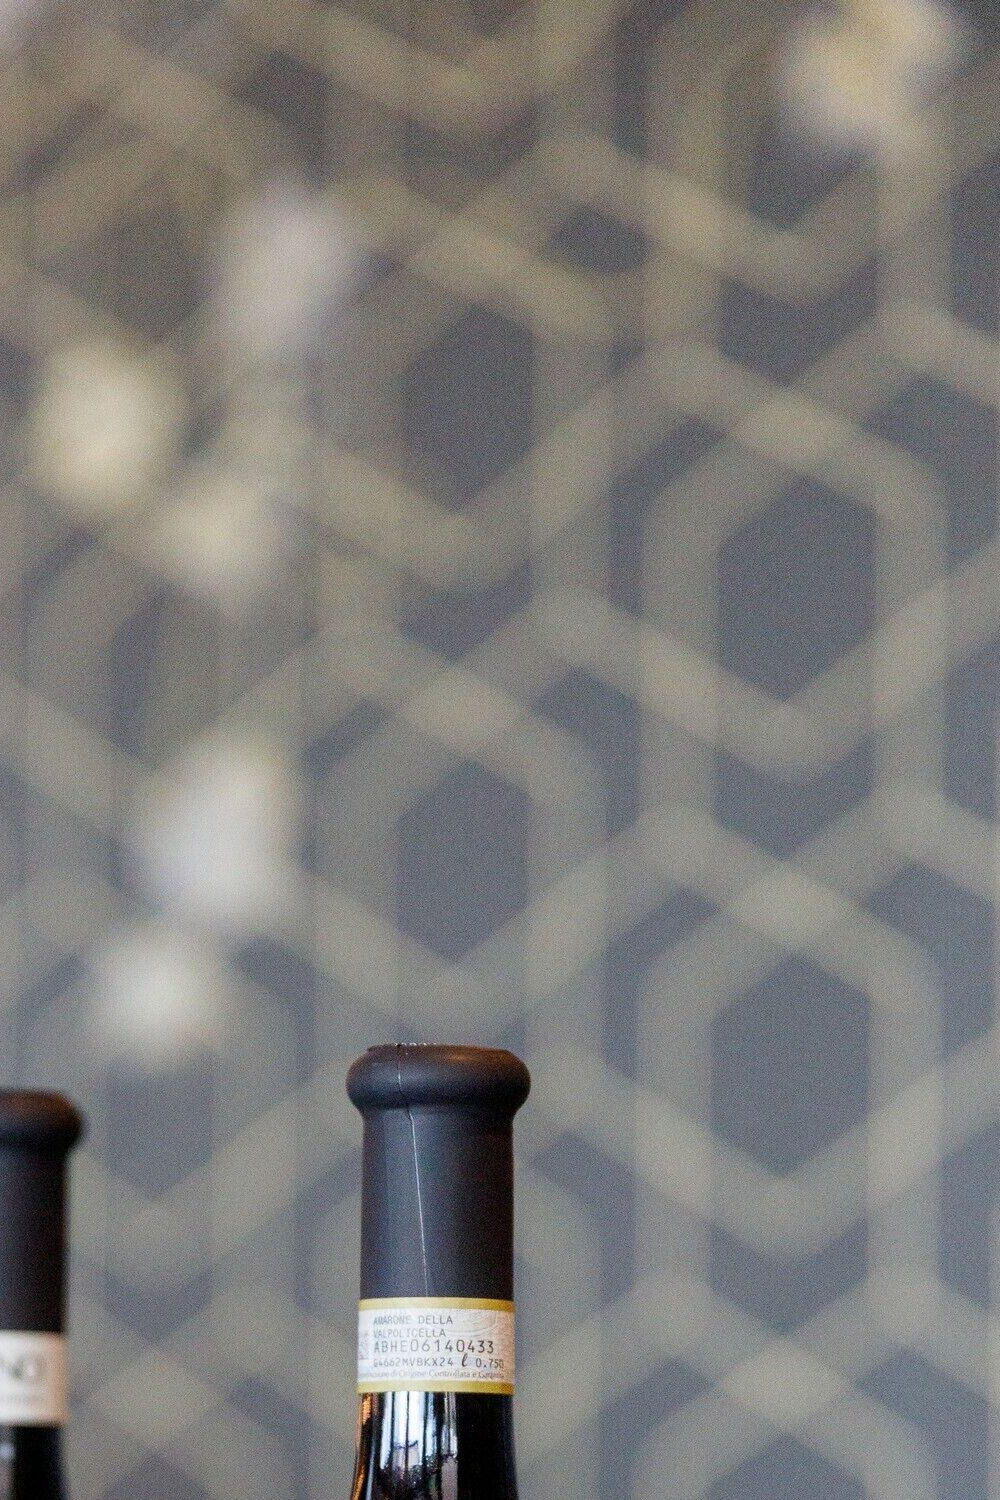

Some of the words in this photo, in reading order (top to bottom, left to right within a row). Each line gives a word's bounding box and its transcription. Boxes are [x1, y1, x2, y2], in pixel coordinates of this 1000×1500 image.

[373, 1315, 412, 1326] AMARONE
[418, 1315, 453, 1325] DELLA
[374, 1328, 446, 1338] VALPOLICELLA
[374, 1339, 494, 1354] ABHE06140433
